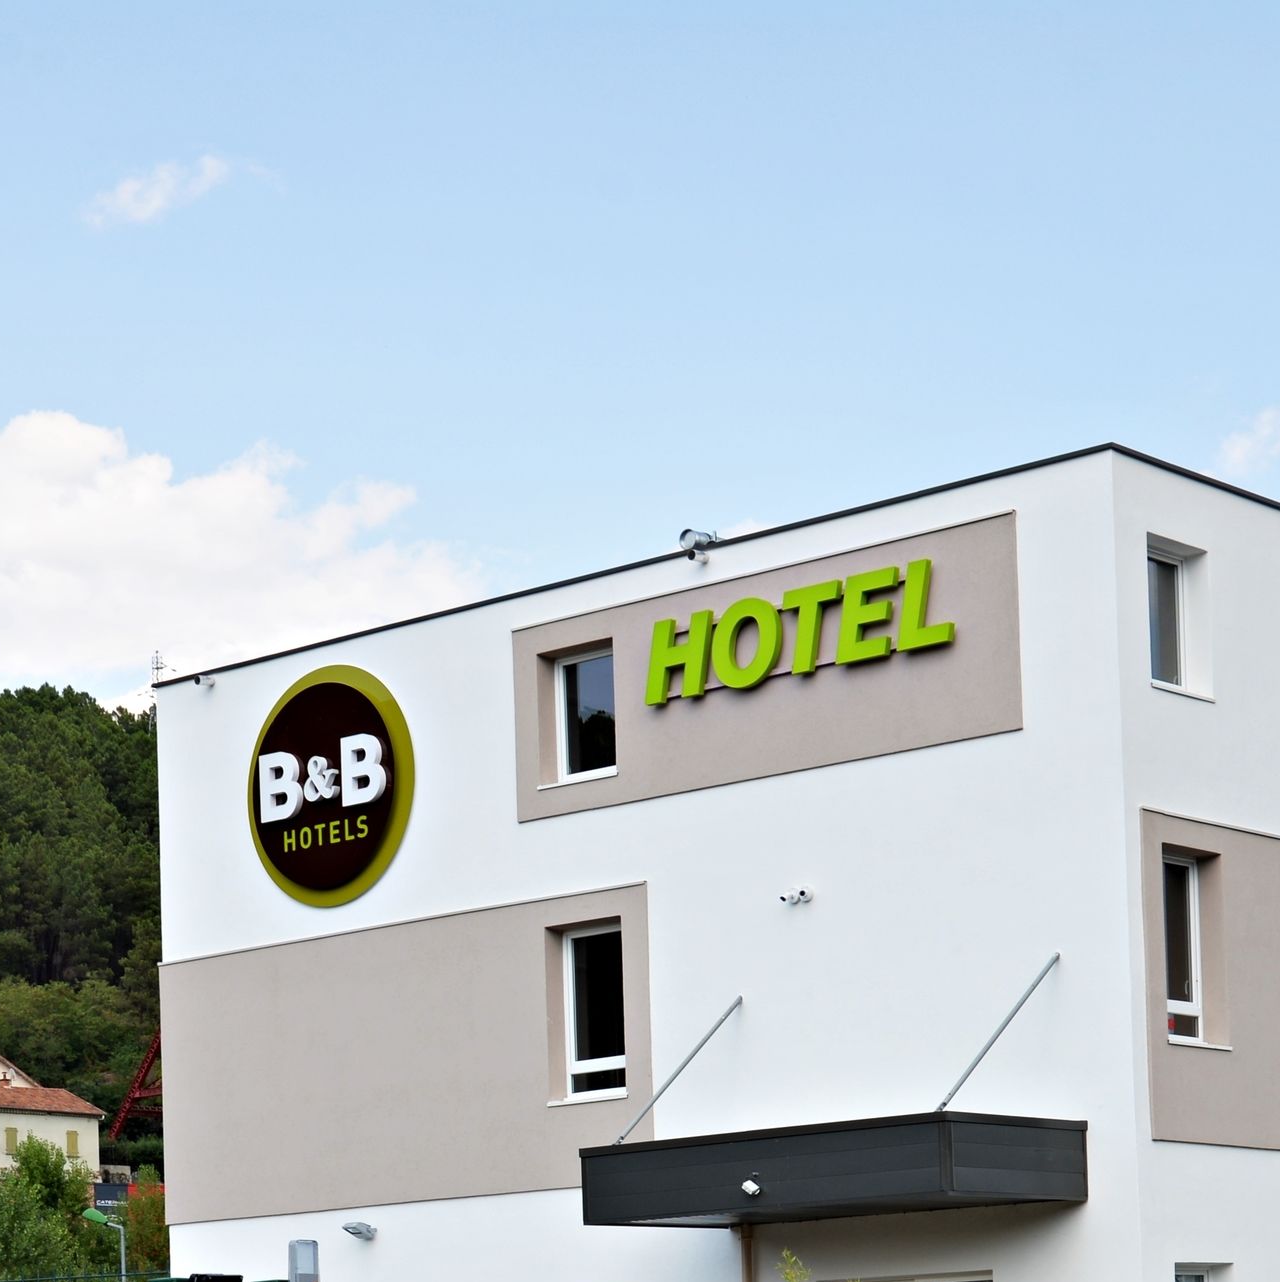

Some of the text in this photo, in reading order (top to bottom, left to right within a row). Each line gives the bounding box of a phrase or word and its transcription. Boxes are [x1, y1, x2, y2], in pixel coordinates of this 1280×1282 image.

[645, 558, 956, 707] HOTEL
[258, 732, 387, 824] B&B
[283, 814, 369, 853] HOTELS
